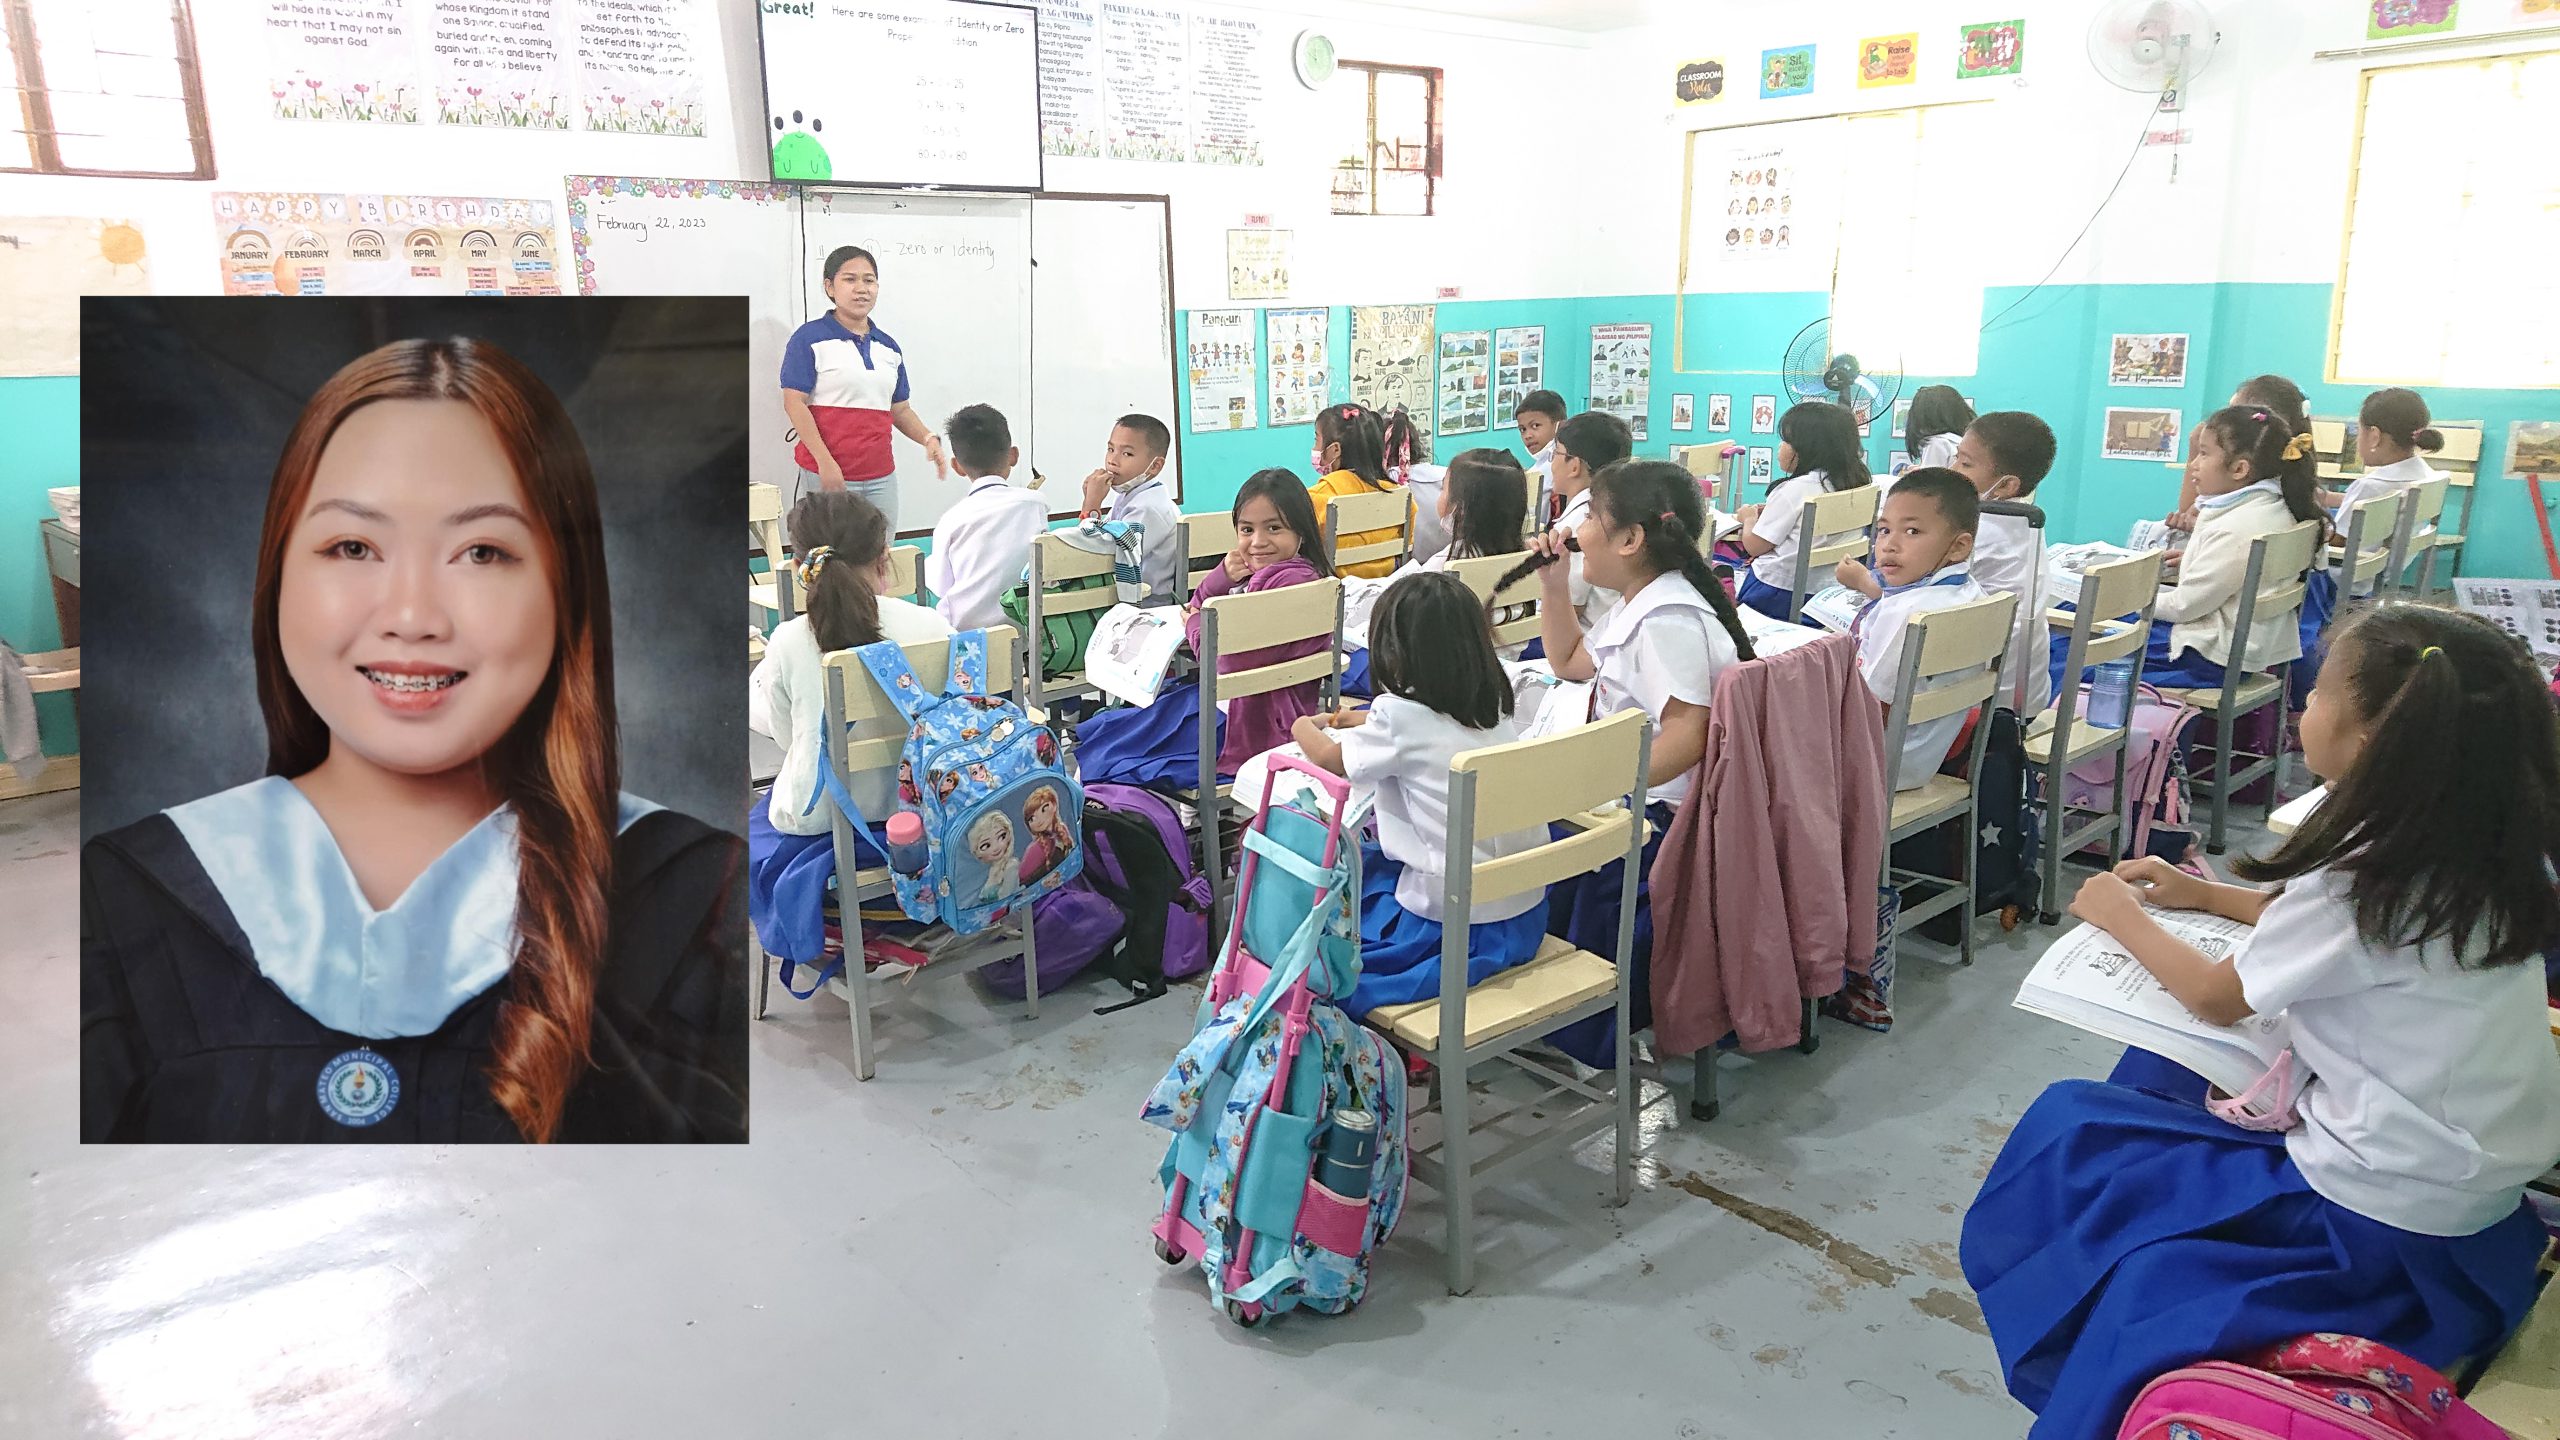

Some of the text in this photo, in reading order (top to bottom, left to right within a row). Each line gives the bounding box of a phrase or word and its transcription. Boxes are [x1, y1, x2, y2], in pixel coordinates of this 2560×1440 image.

[435, 3, 467, 13] whose
[469, 4, 510, 16] Kingdom
[521, 9, 550, 18] stand
[639, 3, 663, 13] which
[762, 0, 814, 19] Great!
[376, 11, 394, 21] my
[442, 17, 461, 25] one
[596, 13, 613, 22] set
[615, 13, 643, 24] forth
[644, 15, 656, 25] to
[831, 4, 855, 17] Here
[858, 10, 874, 19] are
[876, 12, 900, 22] some
[957, 17, 991, 32] Identity
[992, 23, 1003, 32] or
[1004, 22, 1025, 34] Zero
[266, 18, 298, 28] heart
[302, 20, 326, 30] that
[339, 23, 363, 34] may
[366, 26, 384, 35] not
[387, 26, 402, 36] sin
[304, 35, 344, 46] against
[436, 31, 468, 41] buried
[519, 37, 552, 49] coming
[593, 37, 627, 48] defend
[434, 44, 461, 55] again
[506, 49, 524, 58] and
[525, 49, 558, 62] liberty
[1887, 45, 1912, 55] Raise
[453, 58, 470, 67] for
[473, 60, 484, 68] all
[1788, 54, 1803, 67] Sit
[1680, 70, 1722, 83] CLASSROOM
[1689, 80, 1712, 97] Rules
[221, 200, 546, 221] HAPPY BIRTHDAY
[596, 213, 649, 243] February
[678, 217, 707, 229] 2023
[284, 249, 330, 260] FEBRUARY
[352, 249, 383, 259] MARCH
[413, 249, 438, 258] APRIL
[471, 250, 488, 258] MAY
[520, 250, 540, 259] JUNE
[895, 242, 927, 256] Zero
[933, 245, 945, 255] or
[230, 250, 269, 261] JANUARY
[1381, 309, 1425, 326] BAYANI
[331, 1052, 393, 1075] MUNICIPAL
[375, 1079, 400, 1121] COLLEGE
